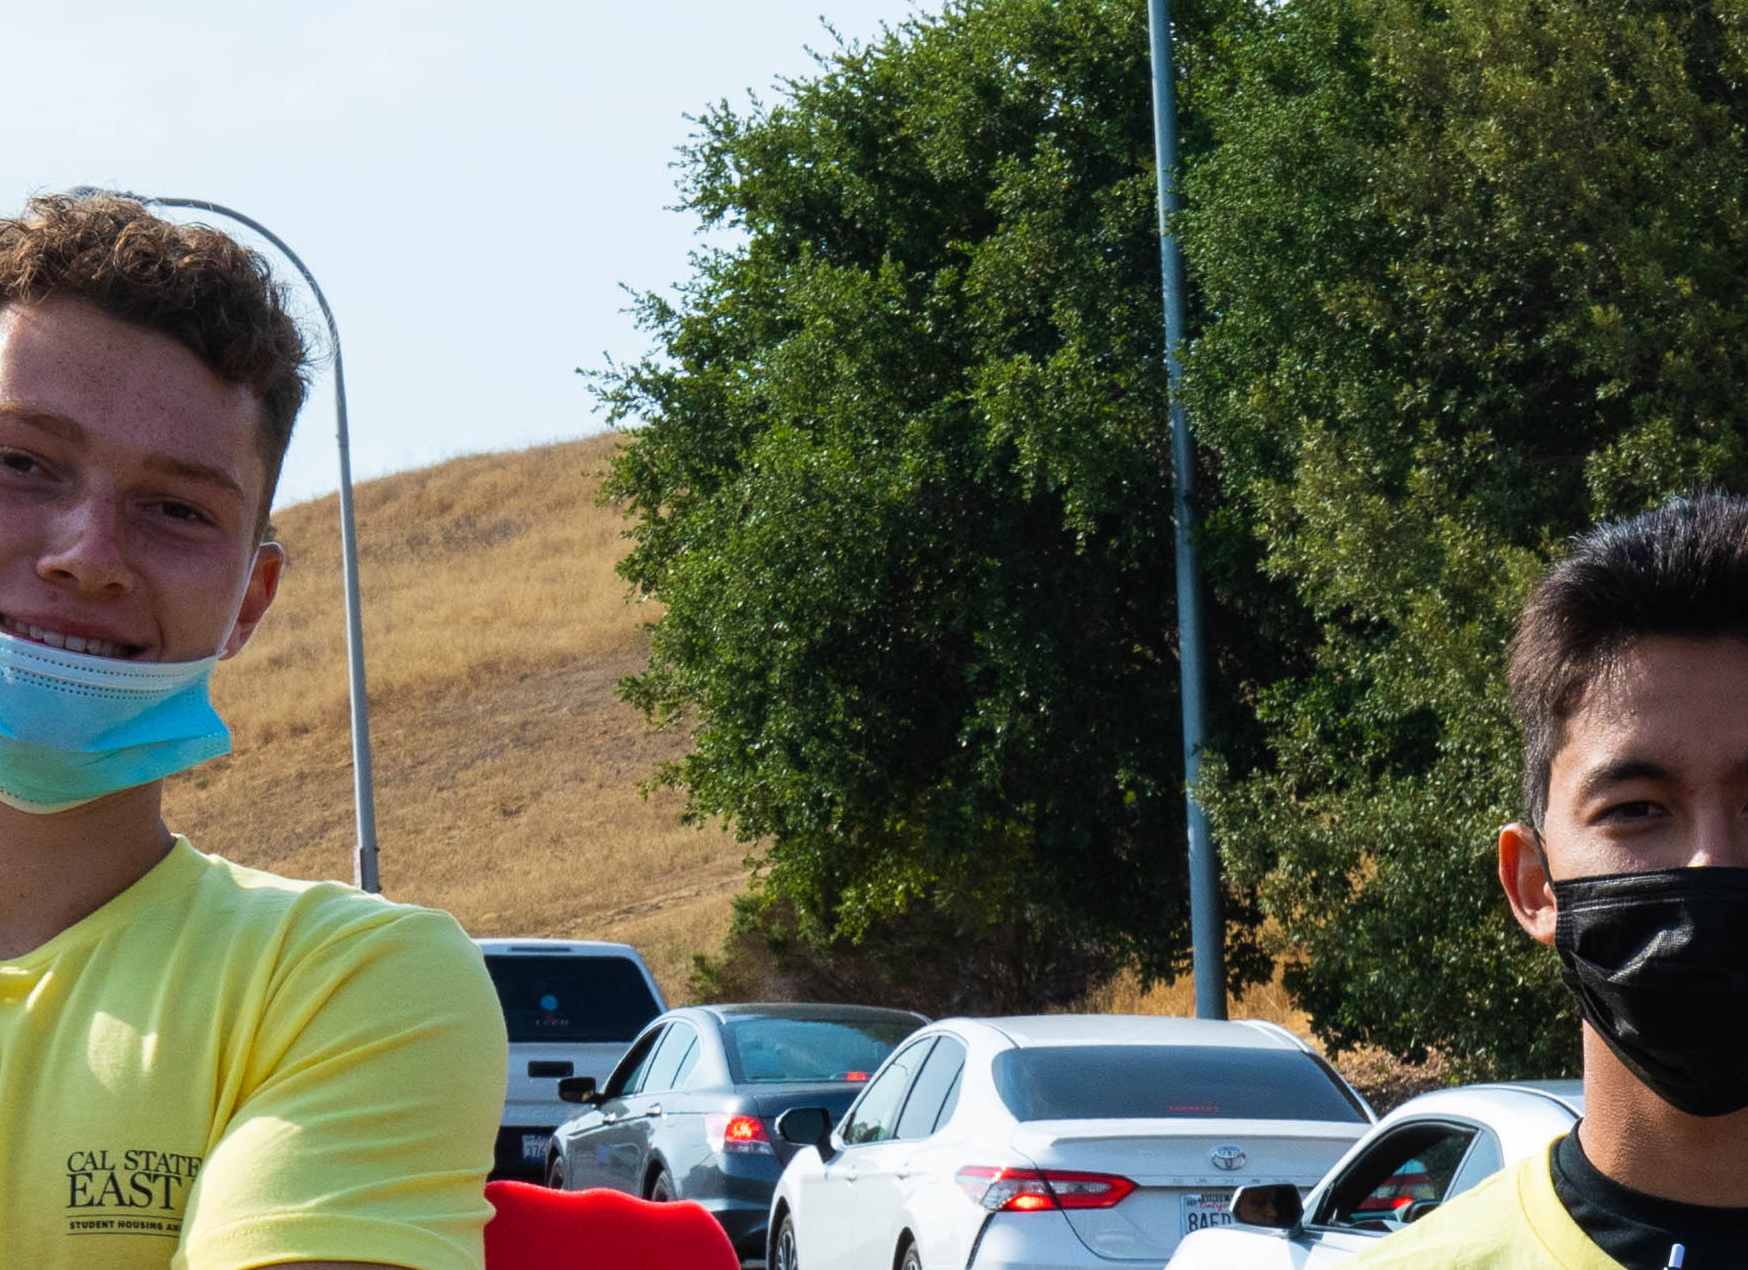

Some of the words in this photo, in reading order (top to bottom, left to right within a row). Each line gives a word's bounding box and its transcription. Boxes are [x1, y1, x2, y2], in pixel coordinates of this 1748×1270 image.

[67, 1150, 115, 1172] CAL
[124, 1150, 202, 1177] STATE
[66, 1172, 182, 1210] EAST
[69, 1220, 114, 1230] STUDENT
[117, 1220, 163, 1231] HOUSING
